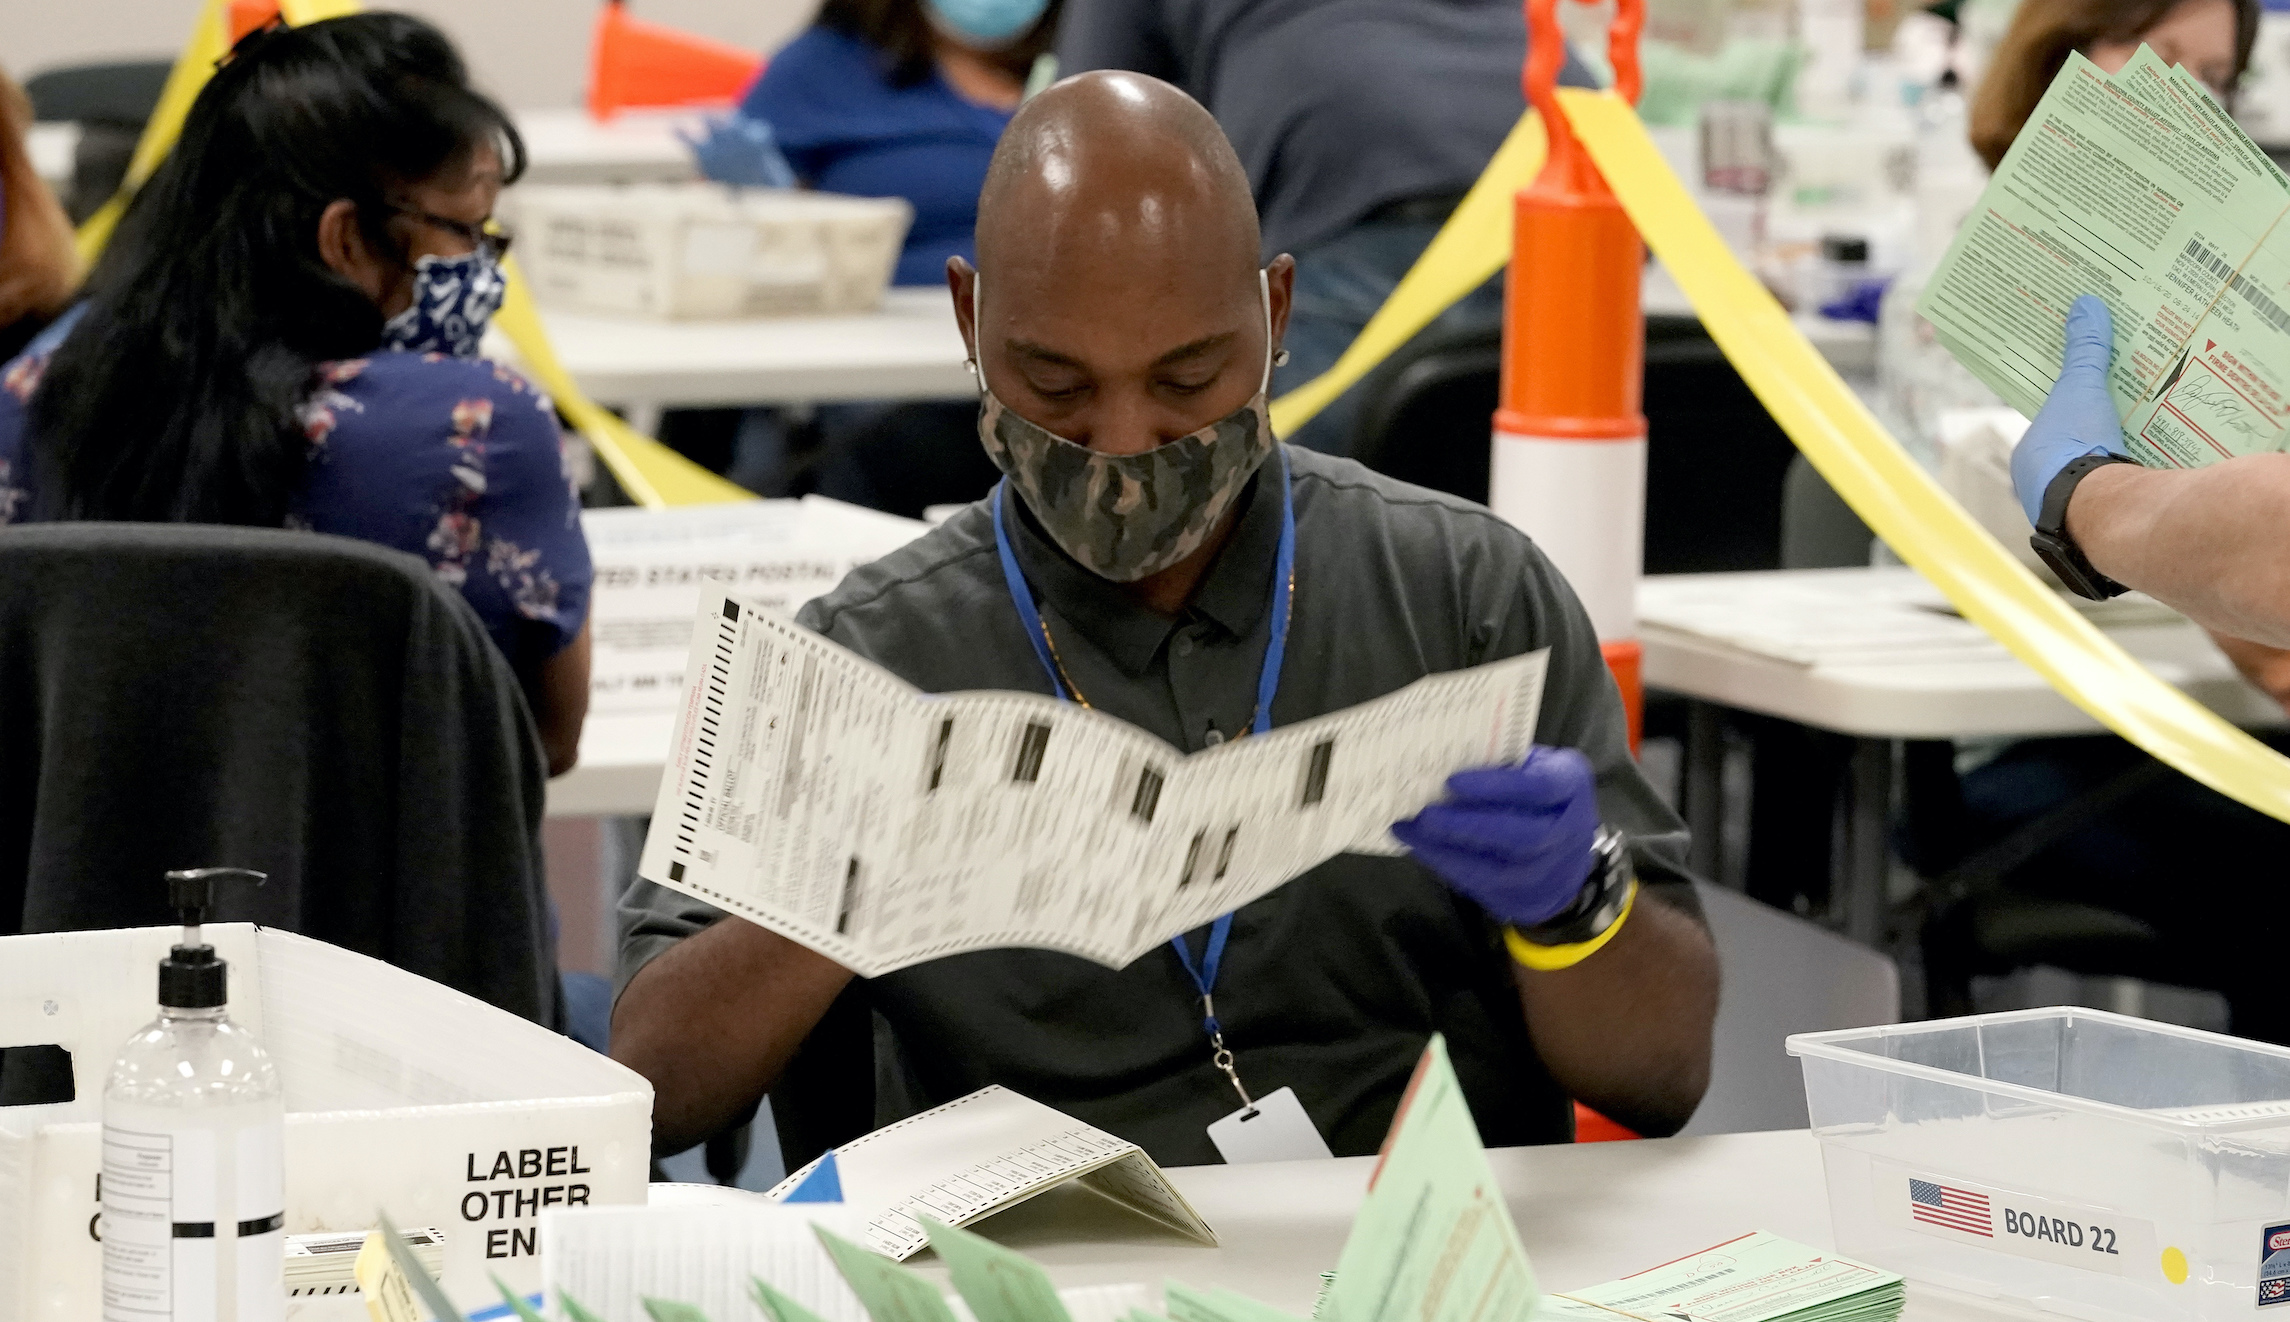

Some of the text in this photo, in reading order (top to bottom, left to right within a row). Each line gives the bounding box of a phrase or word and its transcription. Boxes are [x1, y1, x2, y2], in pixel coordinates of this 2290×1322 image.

[2178, 252, 2219, 285] MARICOPA COUNTY
[2164, 270, 2194, 295] JENNIFER
[2192, 292, 2223, 318] KATHEEN
[2221, 315, 2241, 333] HEATH
[2207, 354, 2229, 373] FIRME
[2221, 350, 2238, 366] SIGN
[467, 1145, 591, 1182] LABEL
[461, 1183, 590, 1222] OTHER
[486, 1227, 541, 1259] EN
[2004, 1208, 2119, 1255] BOARD 22
